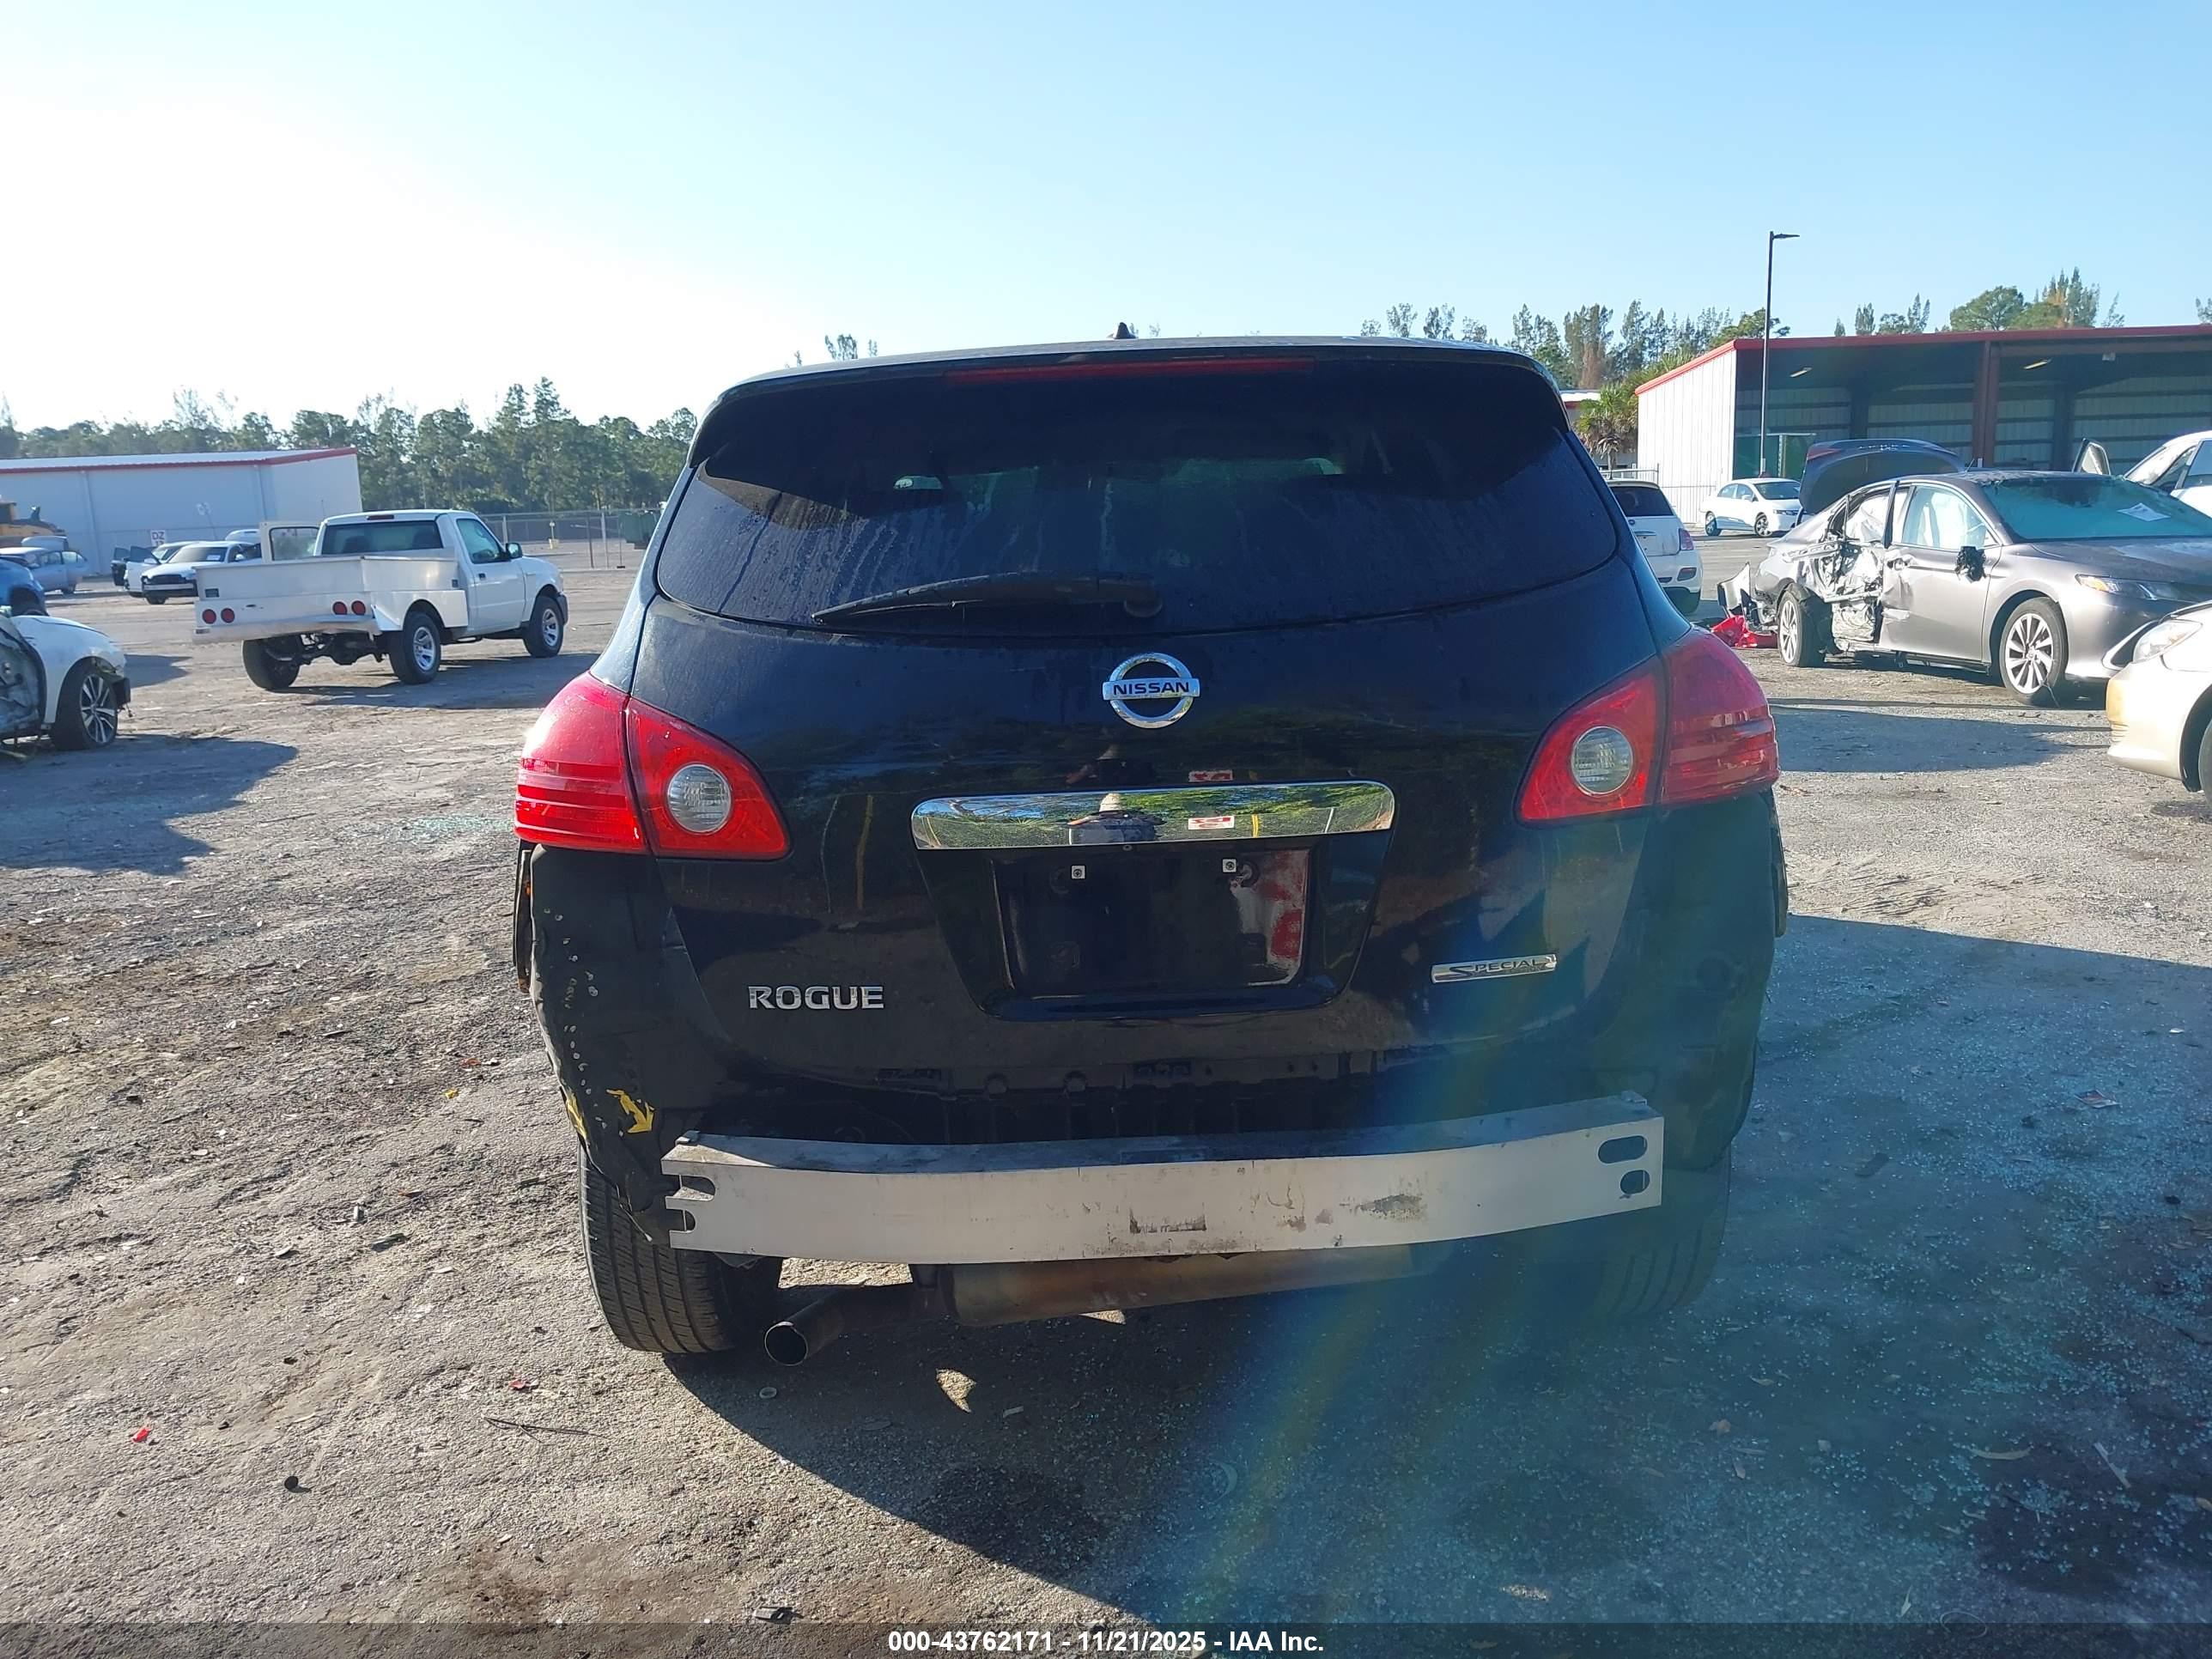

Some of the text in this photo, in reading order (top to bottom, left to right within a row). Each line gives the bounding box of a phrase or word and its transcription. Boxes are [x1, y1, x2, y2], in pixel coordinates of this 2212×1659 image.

[1113, 682, 1189, 695] NISSAN
[1449, 958, 1540, 977] SPECIAL
[748, 986, 884, 1009] ROGUE
